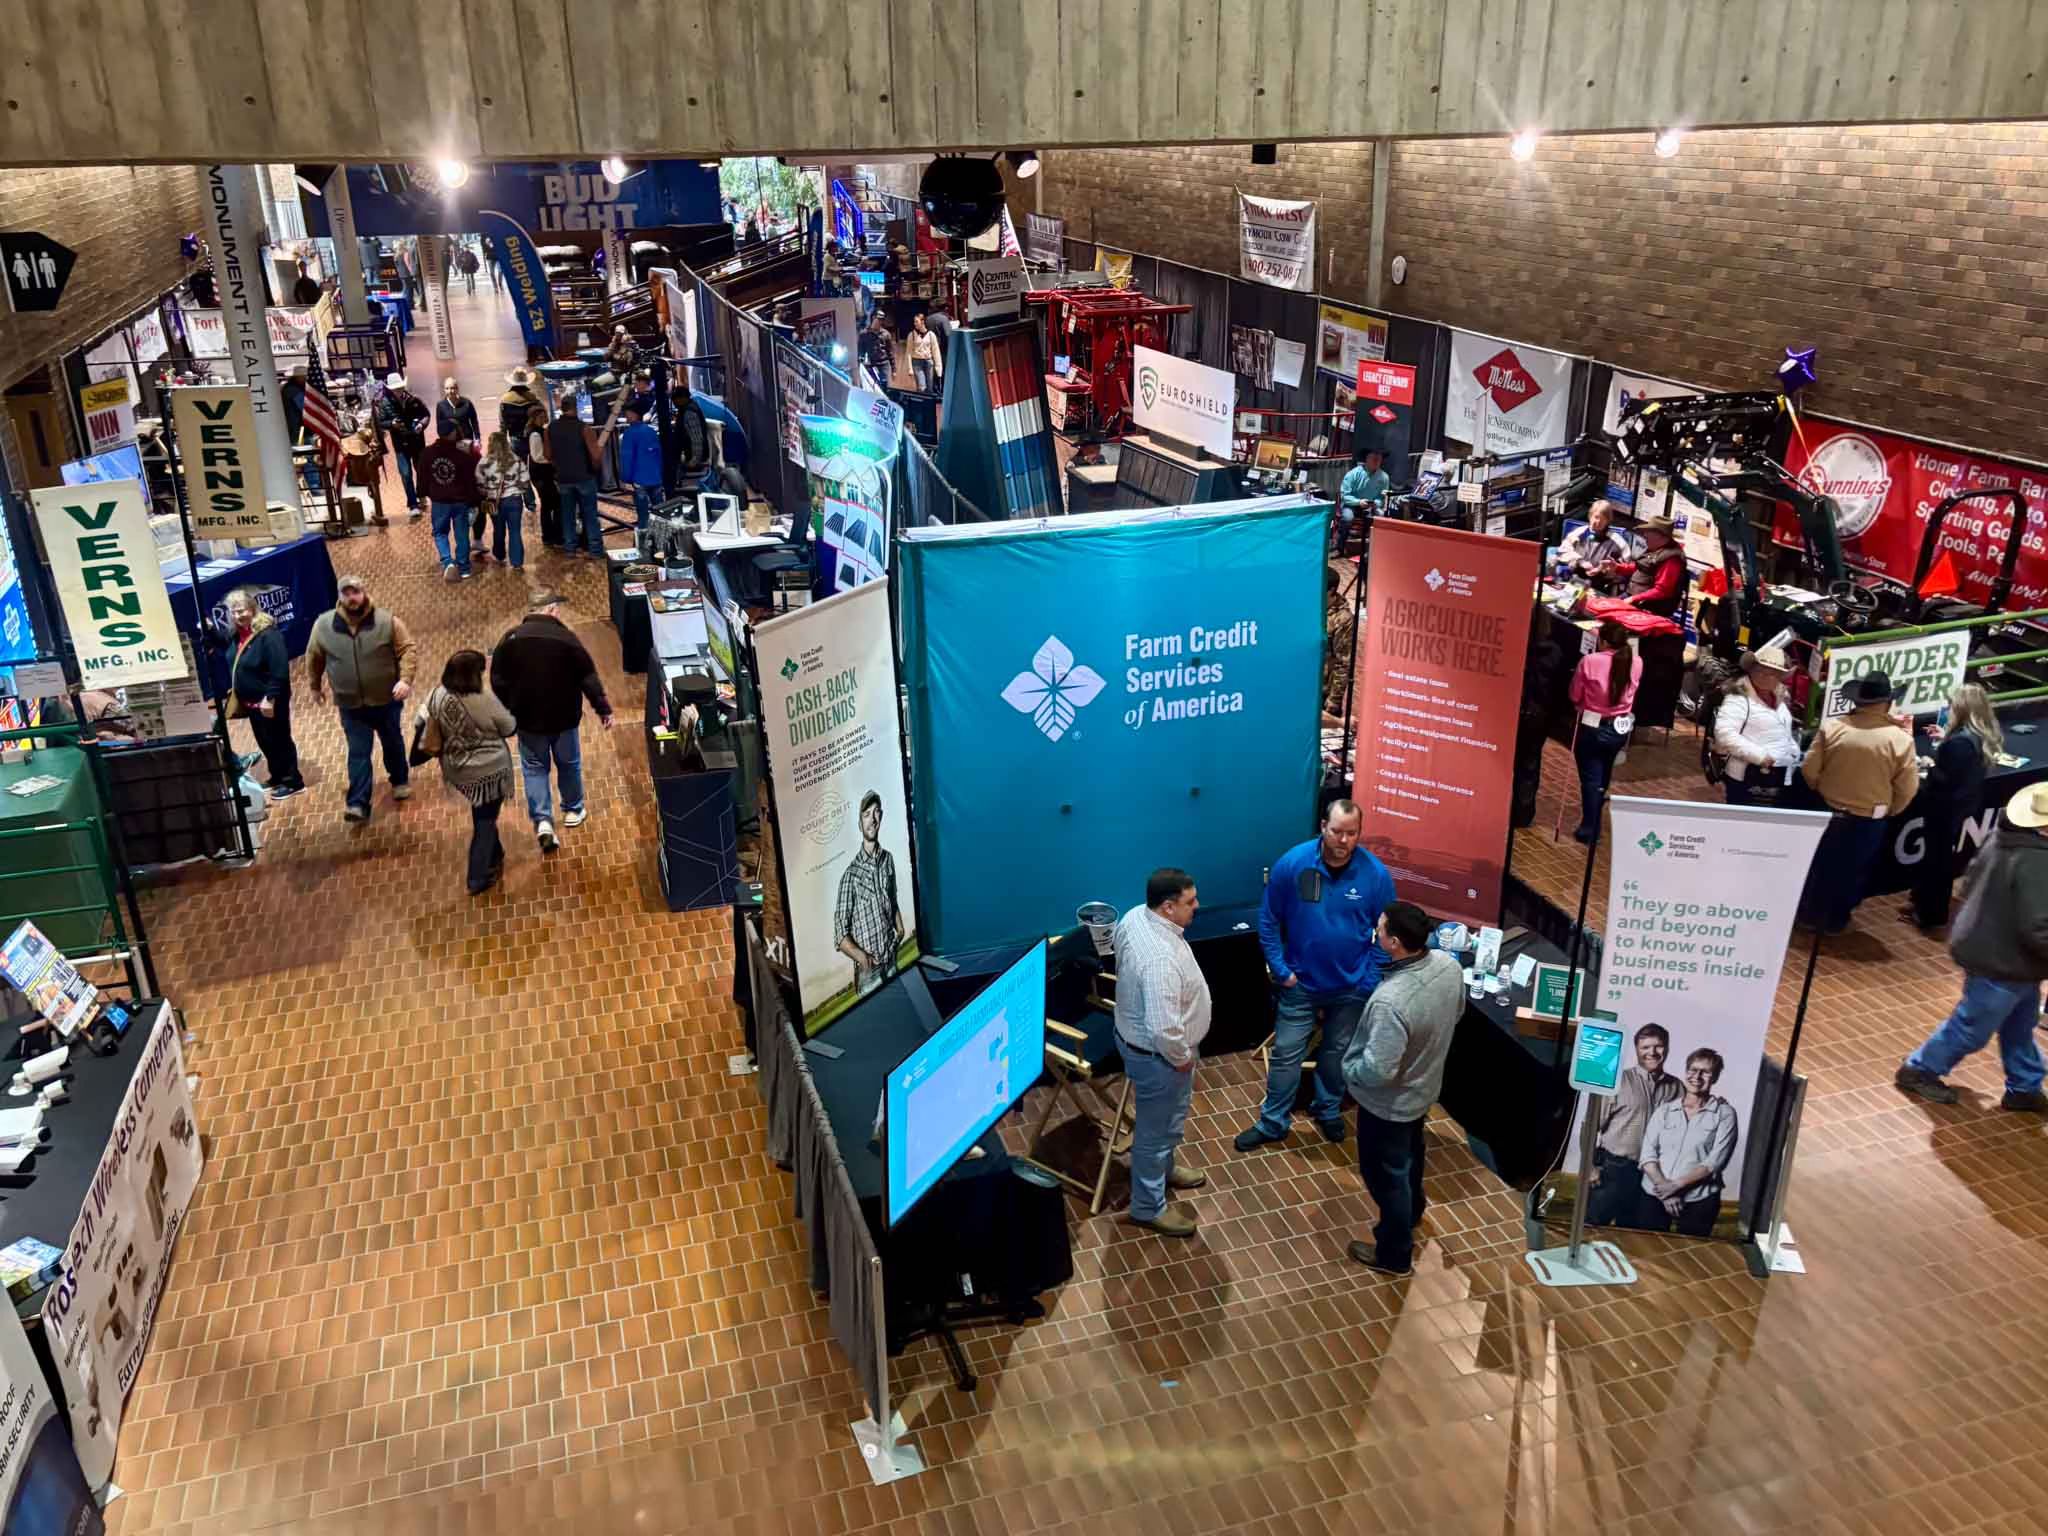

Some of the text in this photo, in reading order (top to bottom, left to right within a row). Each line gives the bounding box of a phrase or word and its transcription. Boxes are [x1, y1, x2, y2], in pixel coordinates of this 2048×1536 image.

[544, 174, 621, 205] BUD
[539, 203, 638, 232] LIGHT
[208, 165, 268, 414] MONUMENT HEALTH
[984, 269, 1018, 283] CENTRAL
[984, 281, 1012, 293] STATES
[193, 317, 220, 331] Fort
[1488, 364, 1527, 394] McNess
[1160, 383, 1228, 416] EUROSHIELD
[88, 409, 121, 441] WIN
[192, 399, 246, 512] VERNS
[236, 514, 264, 526] INC.
[2003, 500, 2047, 528] Ato,
[1987, 521, 2047, 554] Gods,
[62, 500, 147, 648] VERNS
[1382, 596, 1507, 647] AGRICULTURE
[138, 647, 174, 662] INC.
[1125, 620, 1258, 661] Farm Credit
[1379, 626, 1507, 679] WORKS HERE.
[1125, 661, 1224, 694] Services
[1831, 642, 1961, 686] POWDER
[785, 666, 858, 721] CASH-BACK
[788, 698, 857, 748] DIVIDENDS
[1124, 690, 1244, 730] of America
[800, 750, 817, 762] PAYS
[795, 771, 831, 793] DIVIDENDS
[1620, 895, 1768, 923] They go above
[1617, 913, 1737, 942] and beyond
[1615, 933, 1737, 959] to know our
[1609, 972, 1689, 992] and out.
[1612, 952, 1766, 981] business inside
[133, 1015, 175, 1118] Cameras
[92, 1114, 138, 1220] Wireless
[117, 1343, 141, 1393] Farm
[8, 1383, 37, 1451] SECURITY
